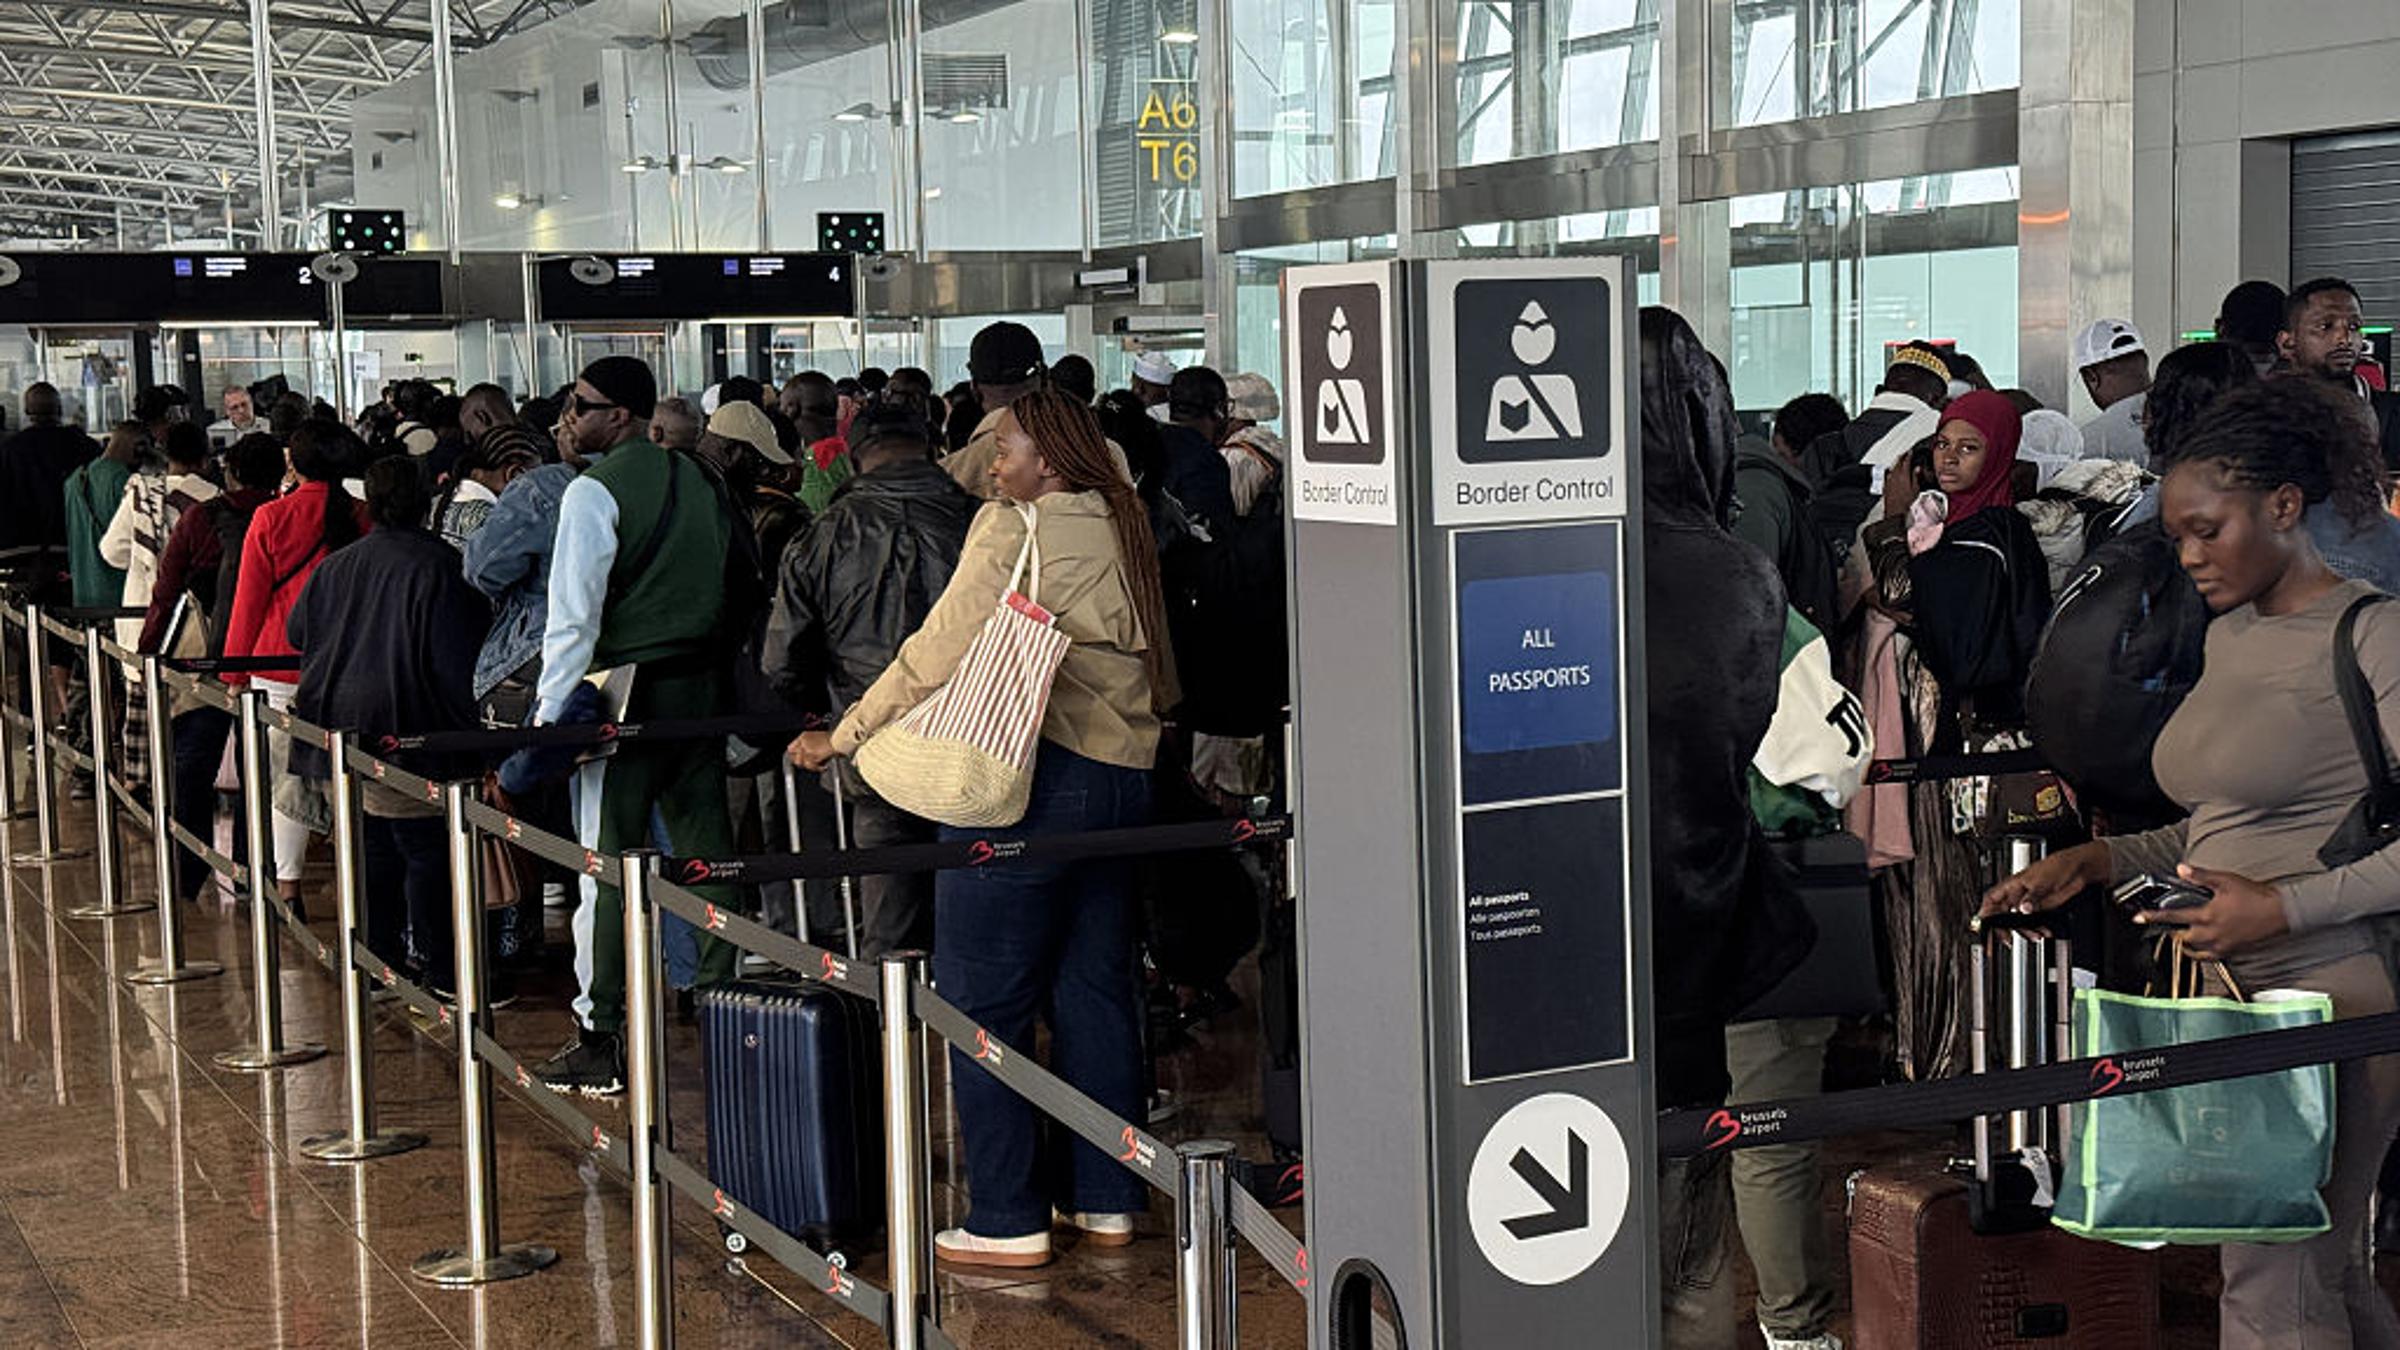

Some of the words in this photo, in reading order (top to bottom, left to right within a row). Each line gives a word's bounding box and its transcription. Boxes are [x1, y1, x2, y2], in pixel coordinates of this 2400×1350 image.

[1138, 89, 1197, 129] A6
[1140, 139, 1198, 182] T6
[299, 266, 312, 284] 2
[829, 266, 840, 282] 4
[1303, 479, 1341, 502] Border
[1345, 482, 1388, 505] Control
[1456, 480, 1530, 505] Border
[1536, 475, 1613, 501] Control
[1521, 628, 1556, 649] ALL
[1489, 664, 1591, 693] PASSPORTS
[2125, 1068, 2160, 1083] airport
[1740, 1108, 1788, 1123] brussels
[1742, 1120, 1781, 1136] airport
